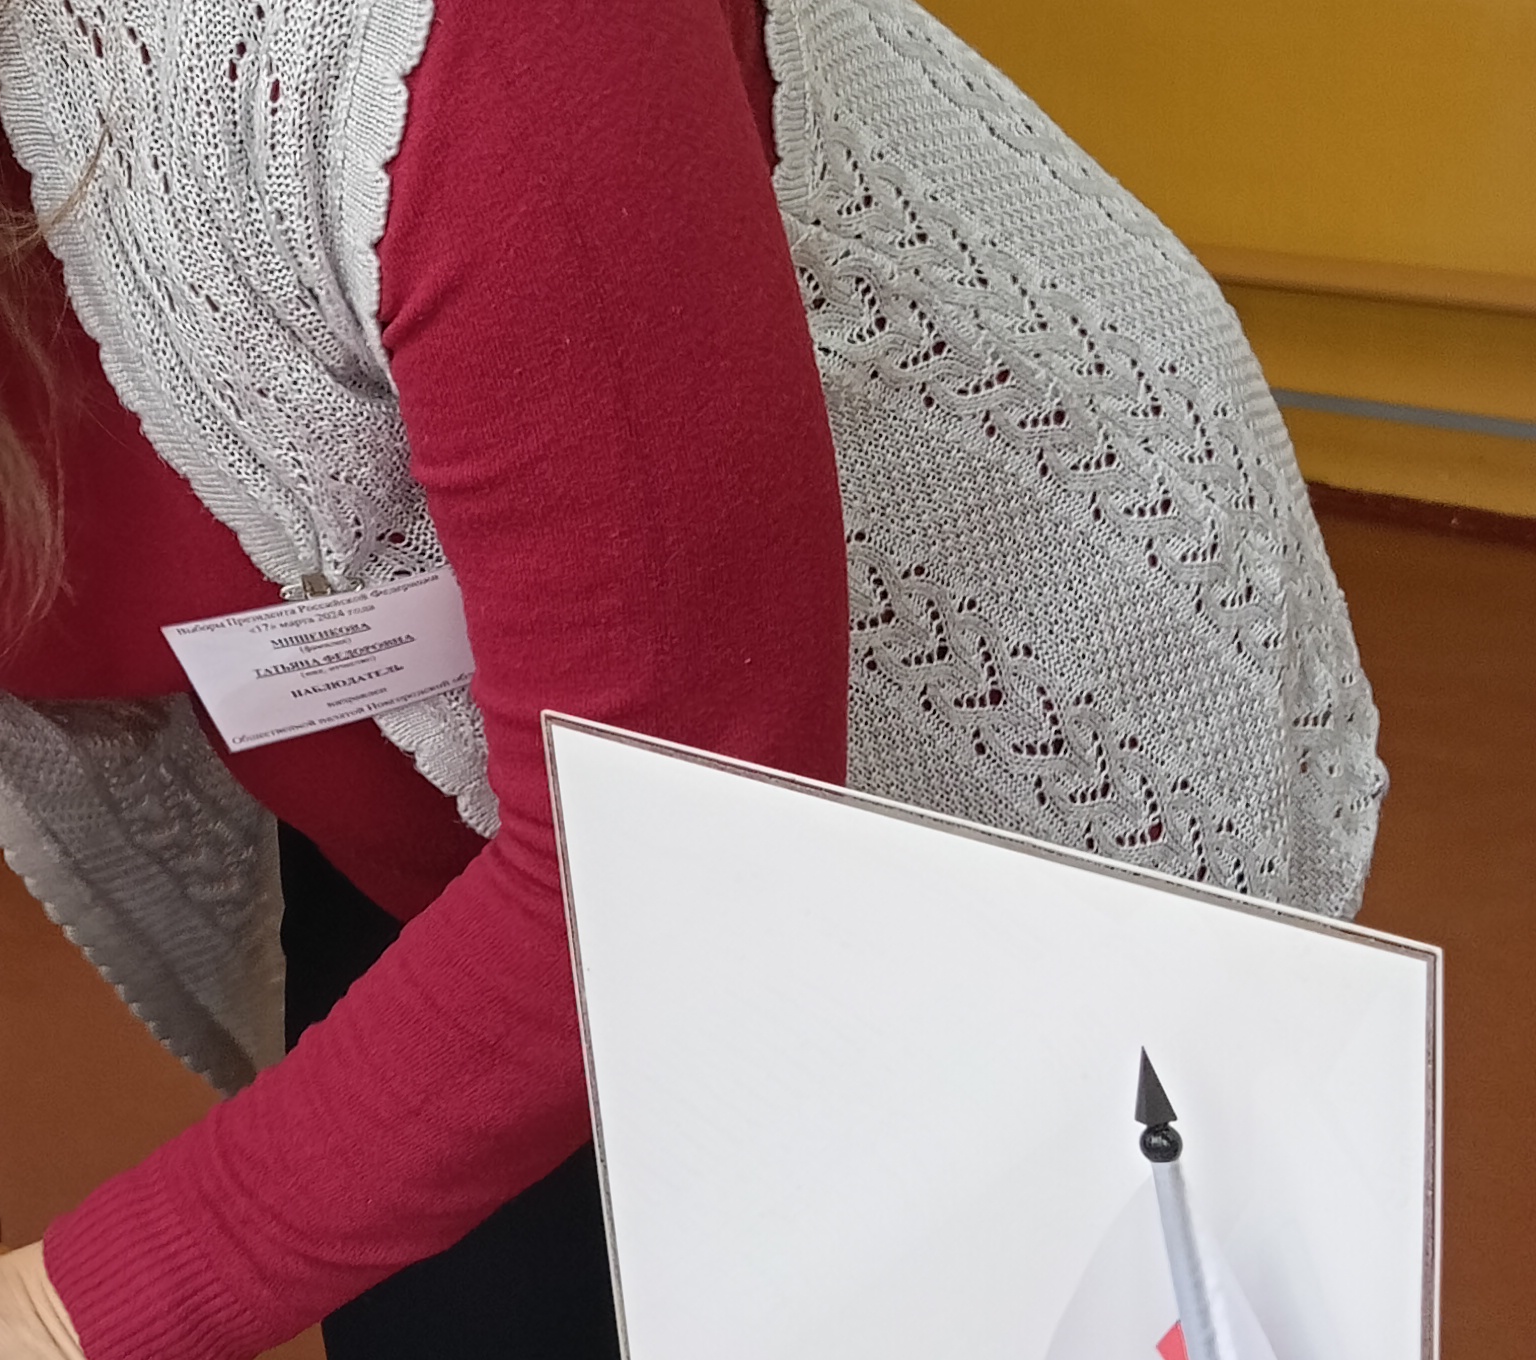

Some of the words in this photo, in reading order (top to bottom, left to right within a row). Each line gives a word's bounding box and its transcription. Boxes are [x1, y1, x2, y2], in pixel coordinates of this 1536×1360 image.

[226, 606, 296, 629] Президента
[299, 592, 368, 614] Российской
[318, 608, 346, 623] 2024
[254, 656, 321, 680] ТАТЬЯНА
[290, 663, 405, 699] НАБЛЮДАТЕЛЬ
